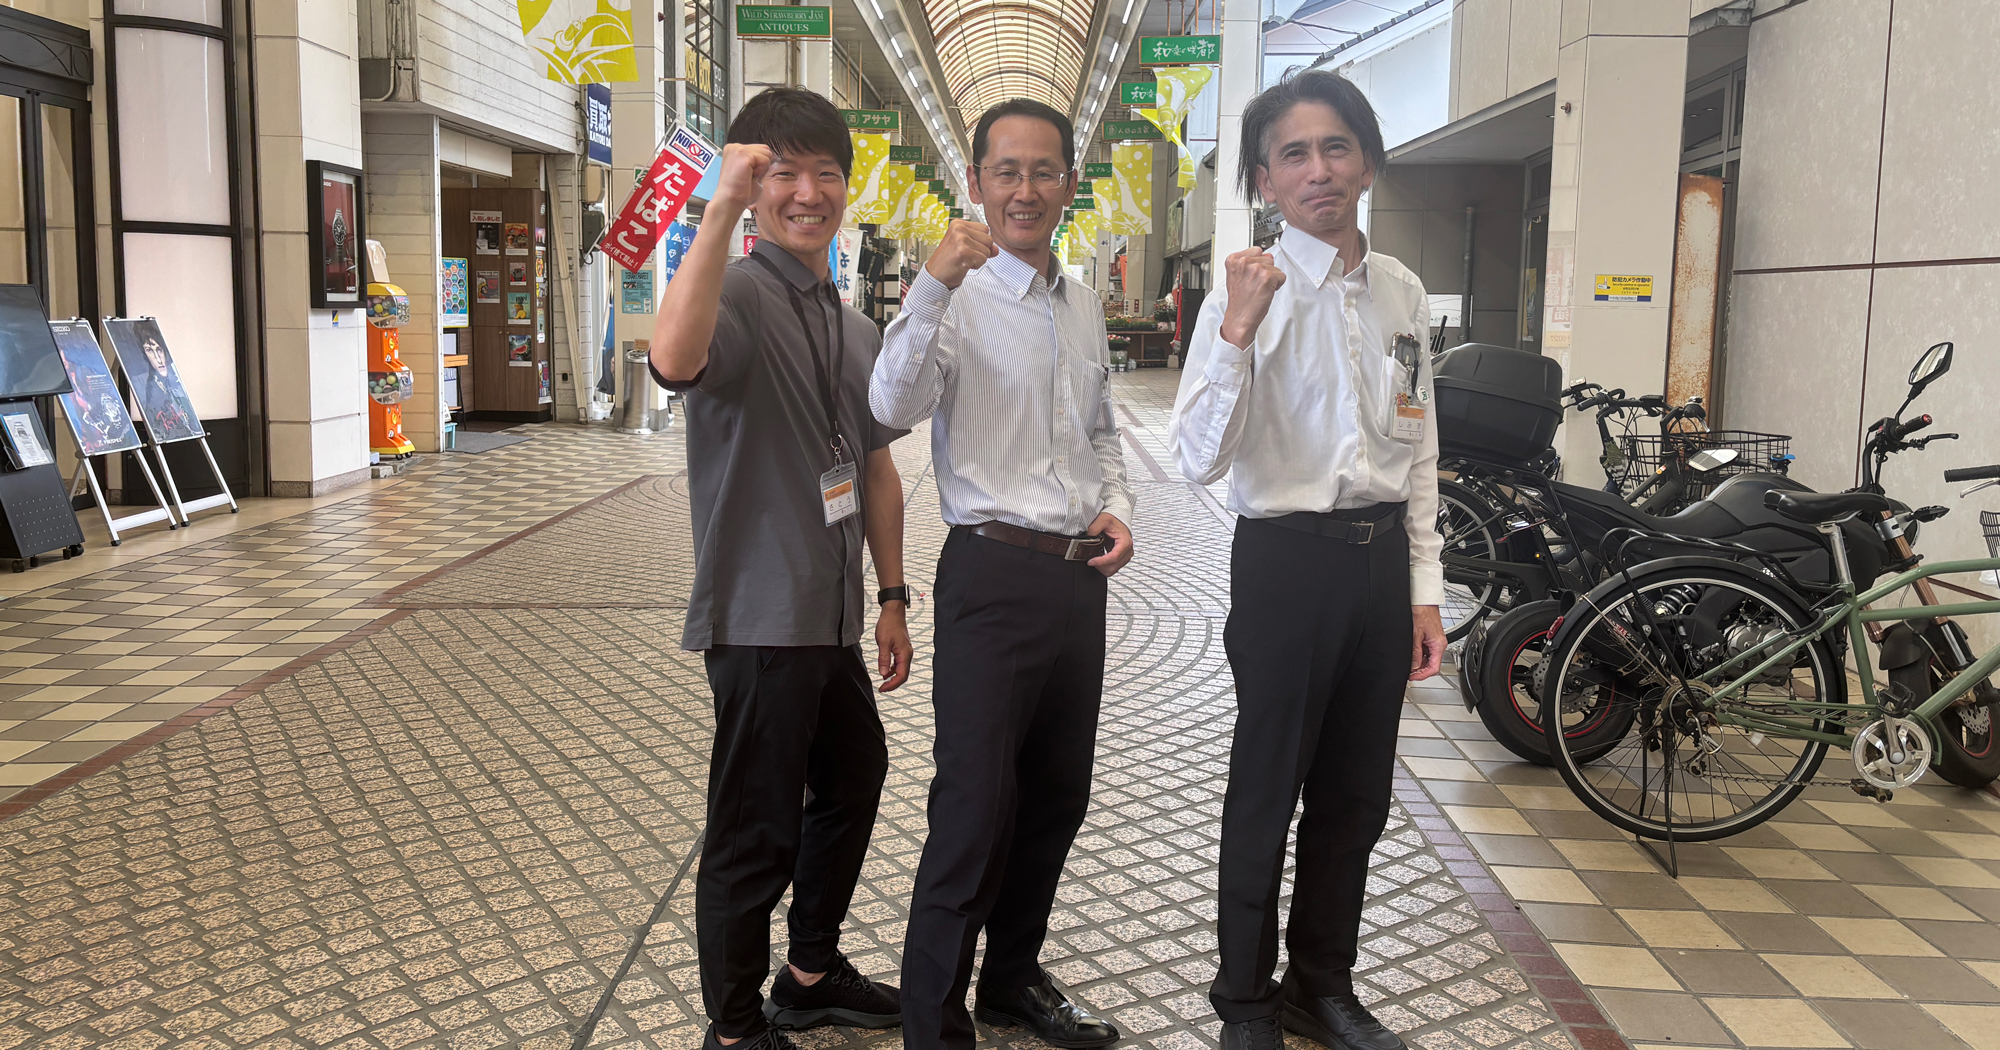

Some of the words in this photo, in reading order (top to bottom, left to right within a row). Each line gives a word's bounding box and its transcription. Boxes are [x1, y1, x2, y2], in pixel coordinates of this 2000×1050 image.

[741, 8, 762, 19] WILD
[763, 9, 808, 20] STRAWBERRY
[808, 10, 824, 20] JAM
[757, 23, 809, 33] ANTIQUES
[861, 114, 892, 126] アサヤ
[617, 161, 687, 255] たばこ
